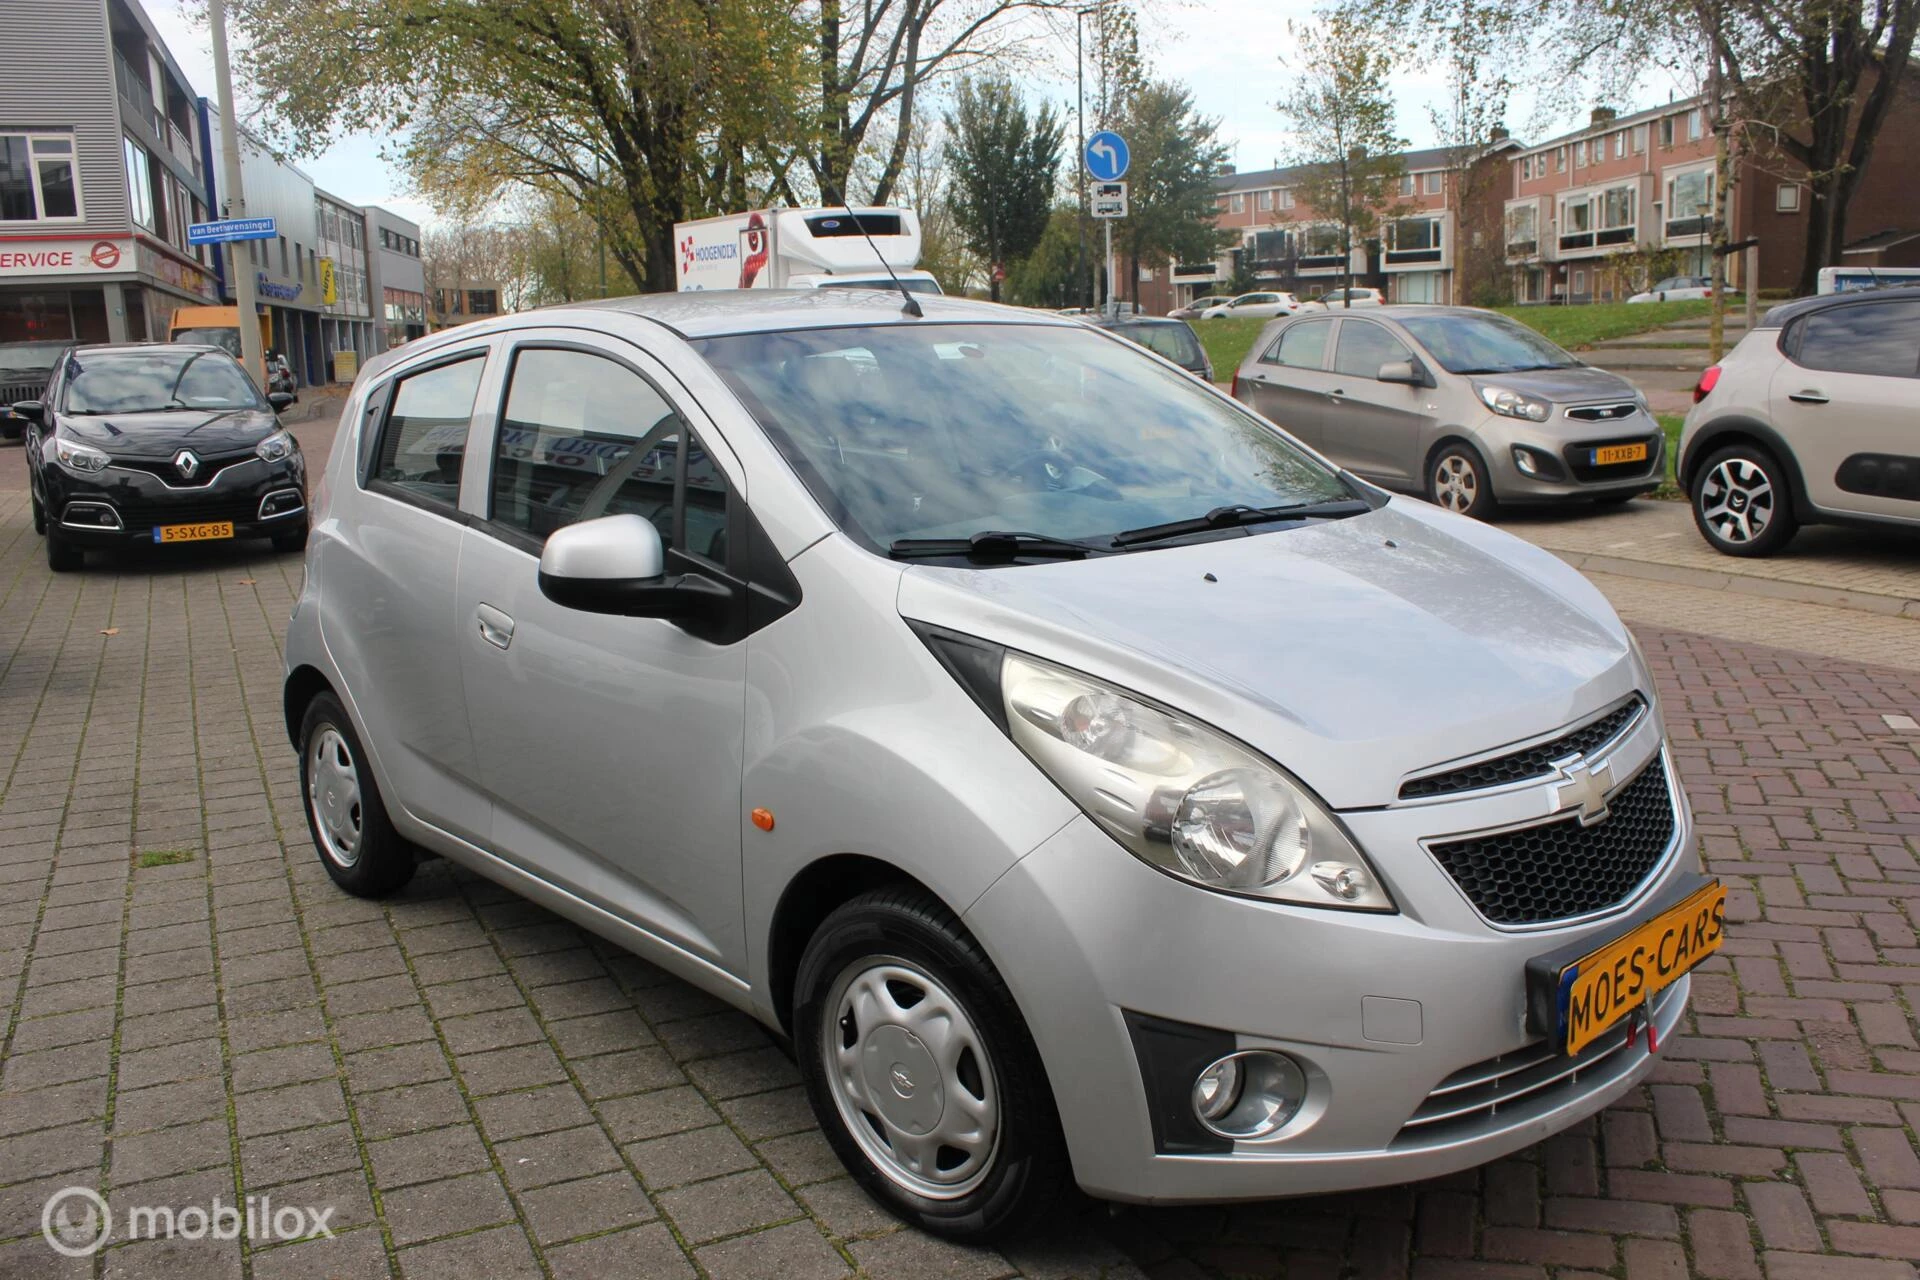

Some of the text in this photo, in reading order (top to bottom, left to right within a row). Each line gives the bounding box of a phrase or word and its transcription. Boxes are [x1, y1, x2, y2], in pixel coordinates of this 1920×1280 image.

[695, 243, 737, 261] HOOGENDIJK
[1602, 446, 1642, 462] 11-XXB-7
[165, 524, 230, 540] 5-SXG-85
[1570, 896, 1725, 1046] MOES-CARS
